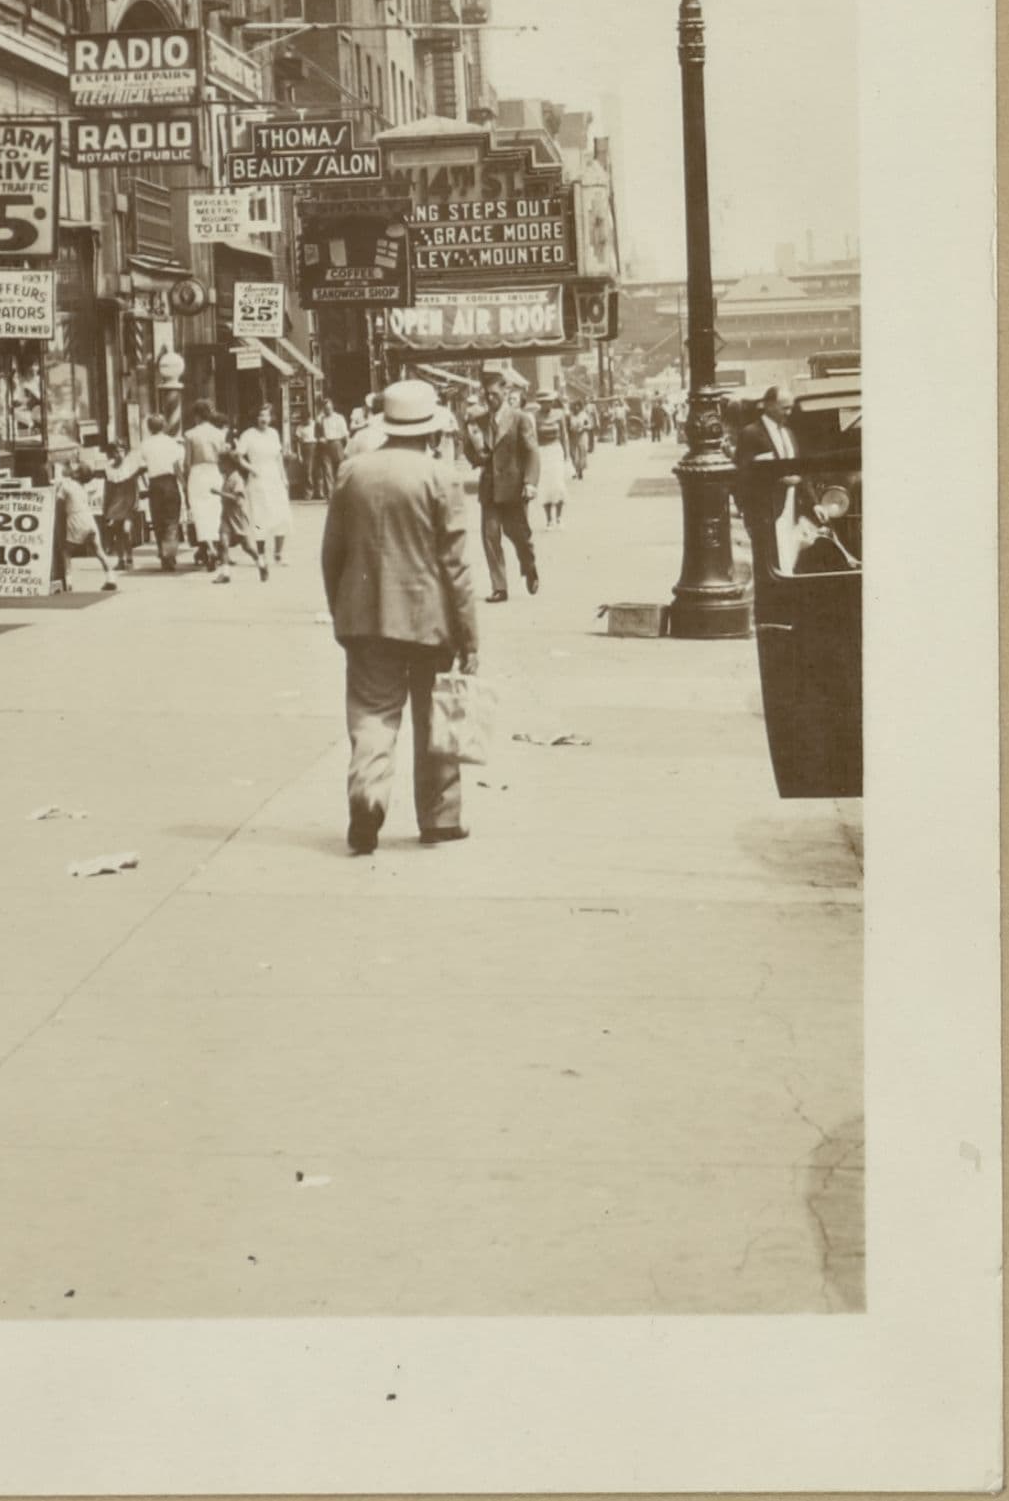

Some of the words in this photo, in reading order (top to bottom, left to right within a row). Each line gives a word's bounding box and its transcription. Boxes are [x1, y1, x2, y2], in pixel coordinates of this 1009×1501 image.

[75, 36, 189, 71] RADIO
[75, 74, 128, 84] EXPERT
[134, 70, 191, 81] REPAIRS
[78, 122, 192, 151] RADIO
[258, 126, 347, 148] THOMAS
[77, 151, 127, 164] NOTARY
[143, 149, 191, 161] PUBLIC
[233, 157, 308, 179] BEAUTY
[313, 154, 376, 176] SALON
[2, 182, 49, 193] TRAFFIC
[196, 207, 238, 215] MEETING
[449, 202, 507, 221] STEPS
[194, 224, 212, 233] TO
[216, 223, 240, 232] LET
[434, 225, 494, 245] GRACE
[504, 221, 563, 242] MOORE
[480, 246, 564, 266] MOUNTED
[367, 287, 397, 299] SHOP
[4, 321, 51, 335] RENEWED
[390, 306, 443, 336] OPEN
[452, 307, 491, 336] AIR
[499, 303, 557, 334] ROOF
